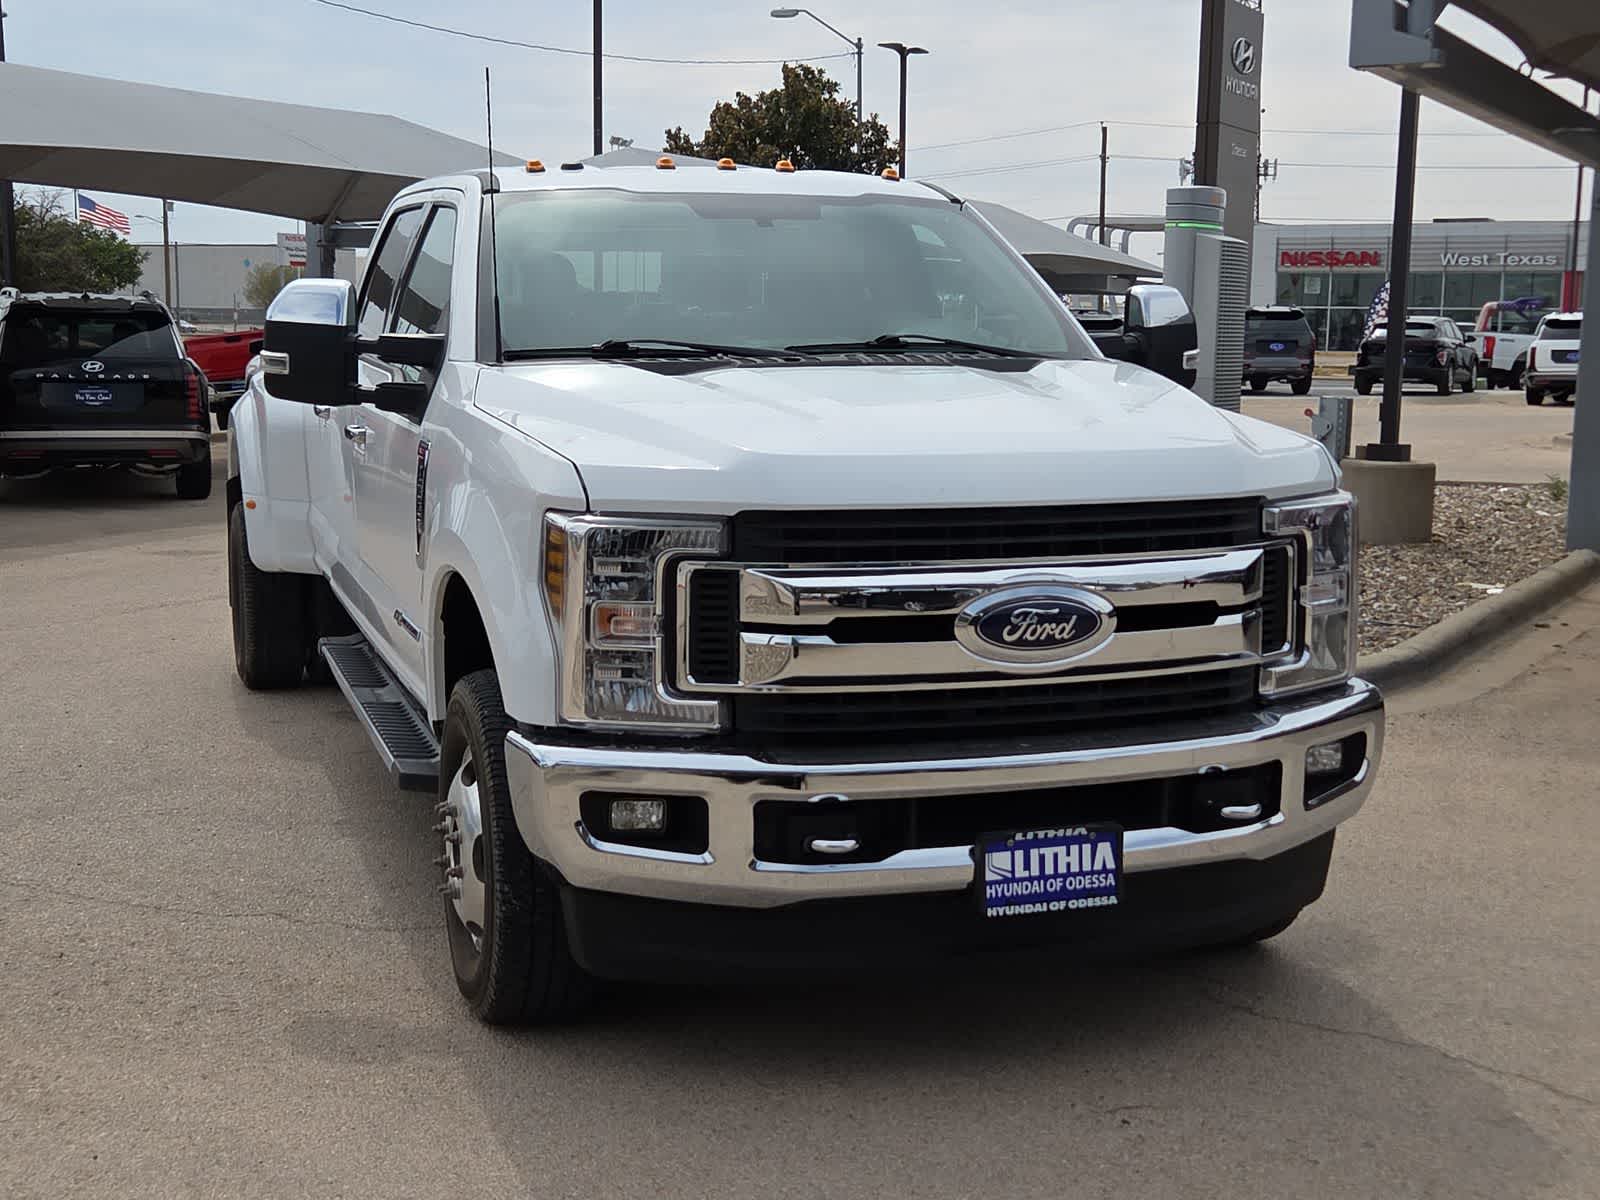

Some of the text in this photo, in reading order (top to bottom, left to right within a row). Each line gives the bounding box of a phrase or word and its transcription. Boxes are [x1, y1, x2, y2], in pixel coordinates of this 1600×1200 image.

[1280, 251, 1380, 267] NISSAN
[1440, 252, 1557, 266] West Texas
[1002, 607, 1078, 642] Ford
[1014, 827, 1088, 841] LITHIA
[1014, 841, 1116, 878] LITHIA
[986, 873, 1116, 899] HYUNDAI OF ODESSA
[987, 895, 1118, 918] HYUNDAI OF ODESSA
